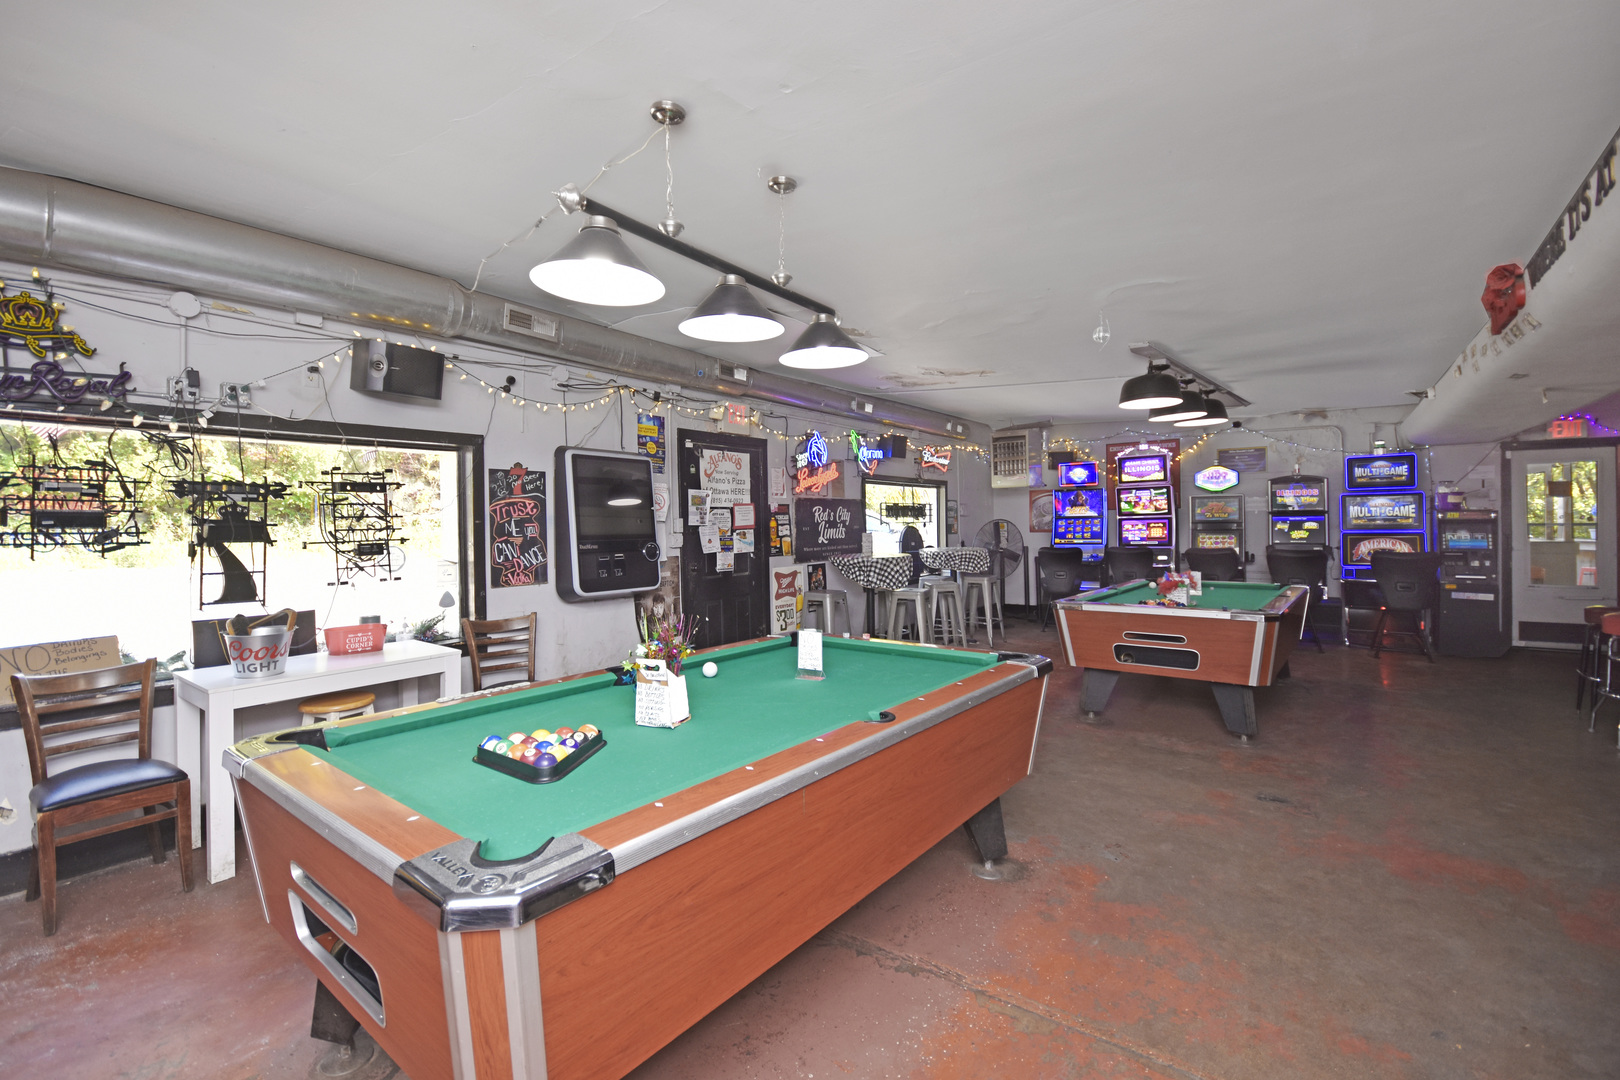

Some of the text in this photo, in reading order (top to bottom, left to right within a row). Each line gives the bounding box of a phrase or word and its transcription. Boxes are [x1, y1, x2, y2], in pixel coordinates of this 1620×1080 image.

[31, 361, 132, 402] Royal
[728, 403, 746, 426] EXIT
[1552, 419, 1582, 438] EXIT
[859, 446, 884, 459] Corona
[704, 452, 742, 478] ALFANO'S
[1124, 465, 1160, 473] ILLINOIS
[1355, 465, 1408, 477] MULTI GAME
[523, 473, 540, 483] Beer
[707, 477, 746, 486] Alfano's Pizza
[709, 487, 730, 495] Ottawa
[812, 506, 851, 525] Red's City
[1350, 504, 1416, 518] MULTI GAME
[505, 517, 523, 536] ME
[818, 521, 846, 544] Limits
[495, 542, 518, 562] CAN
[1359, 538, 1409, 552] AMERICAN
[346, 635, 374, 643] CUPID'S
[346, 641, 374, 650] CORNER
[0, 644, 52, 673] NO
[52, 646, 94, 657] Bodies
[54, 650, 108, 666] Belongings
[229, 640, 289, 662] Coors
[235, 660, 280, 674] LIGHT
[431, 852, 475, 879] VALLEY
